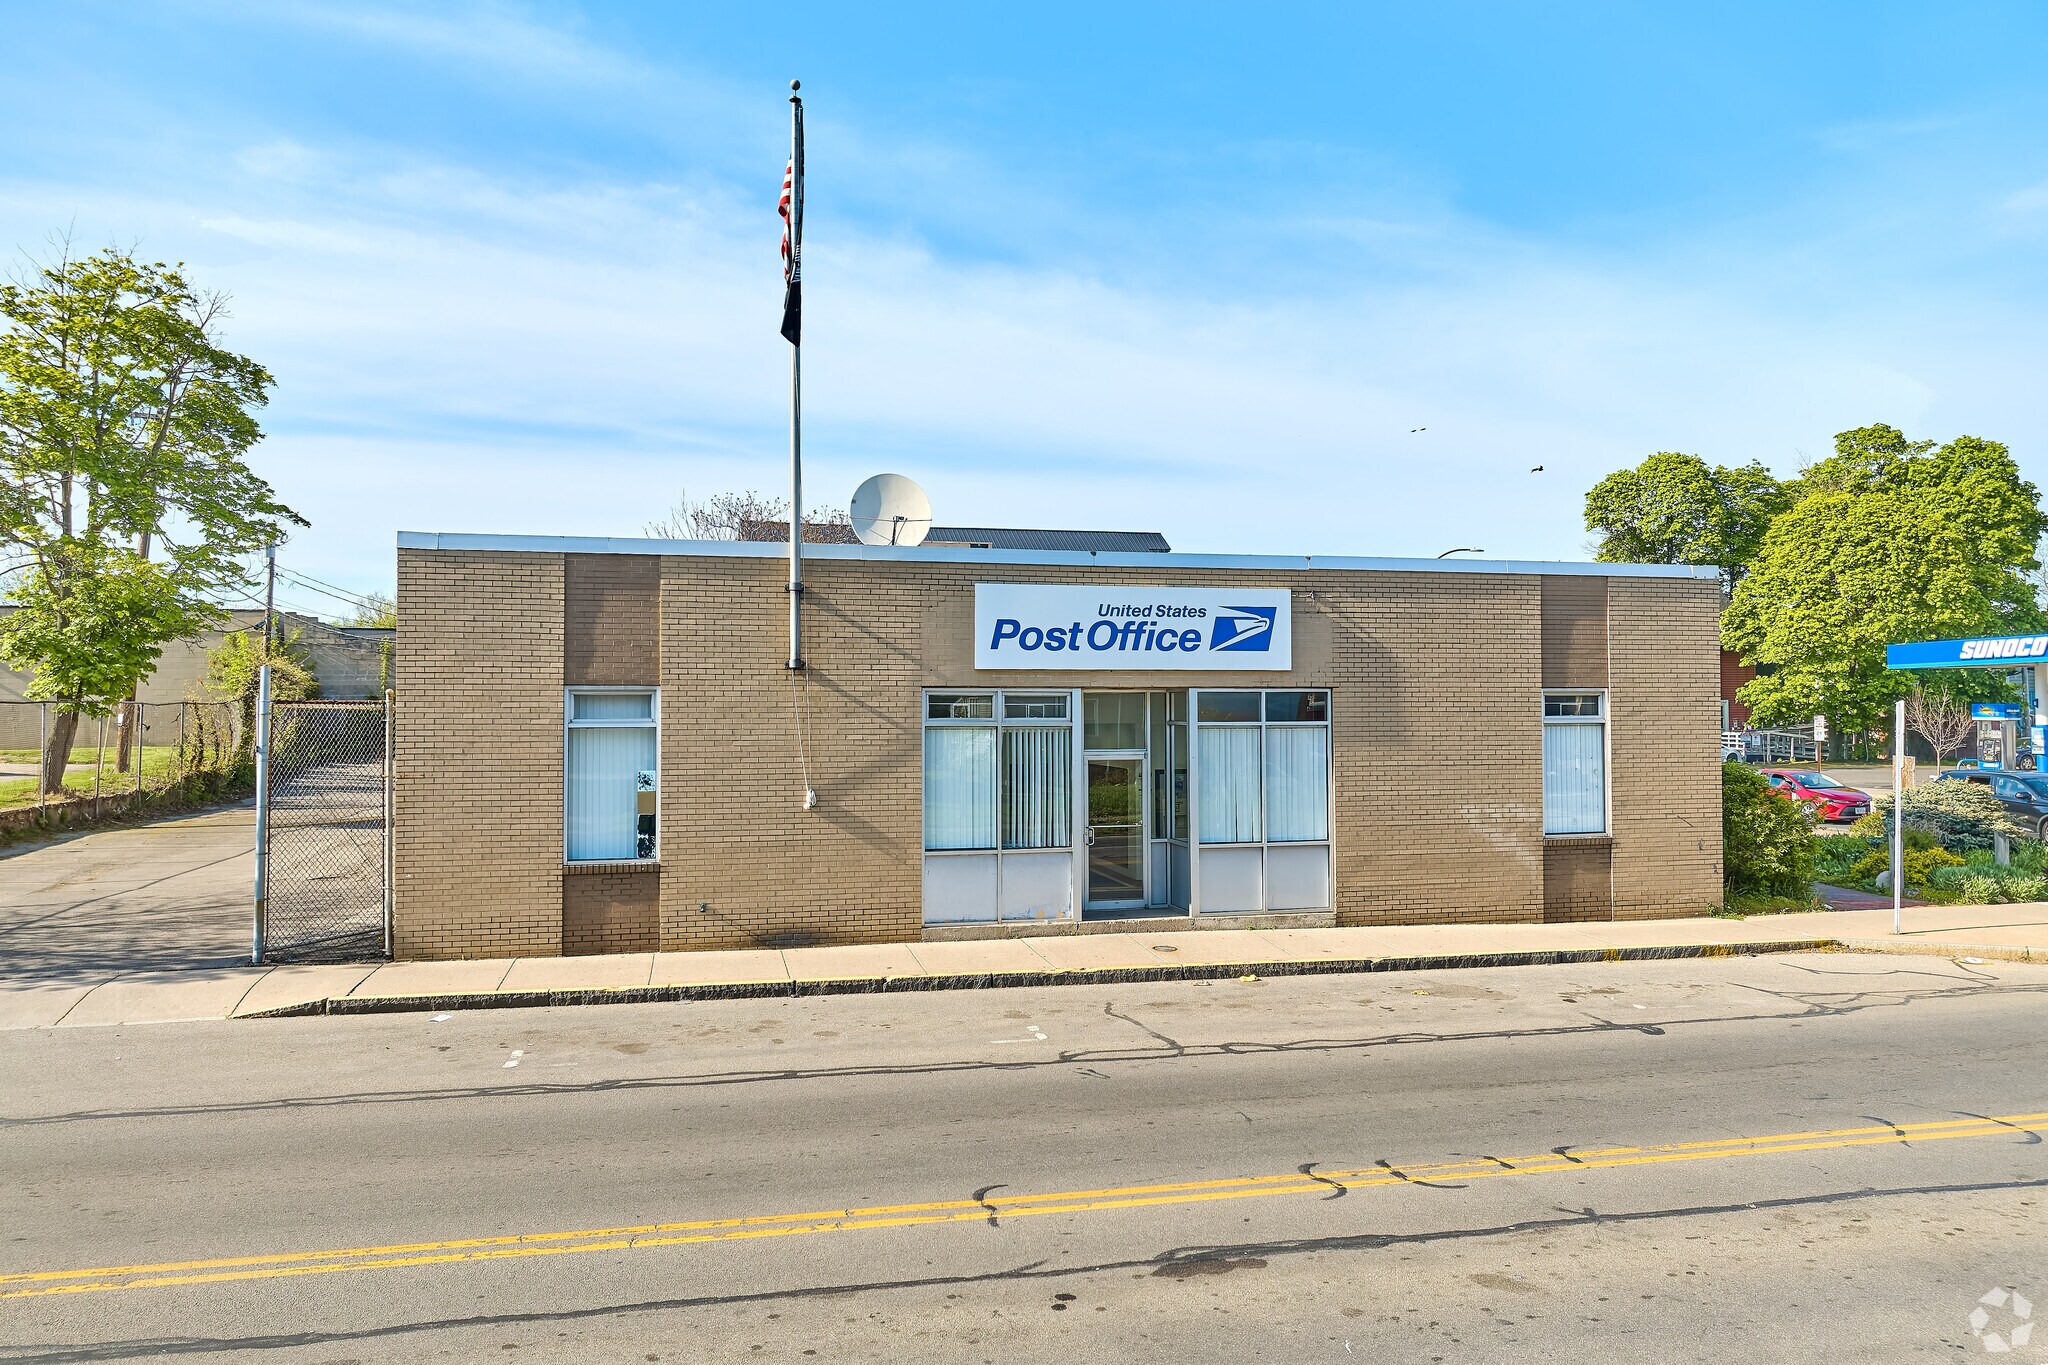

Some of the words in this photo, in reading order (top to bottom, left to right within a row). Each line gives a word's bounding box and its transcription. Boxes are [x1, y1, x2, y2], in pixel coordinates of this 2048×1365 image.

[1097, 603, 1152, 618] United
[1154, 604, 1208, 619] States
[989, 618, 1084, 652] Post
[1086, 619, 1203, 653] Office
[1959, 636, 2048, 660] SUNOCO
